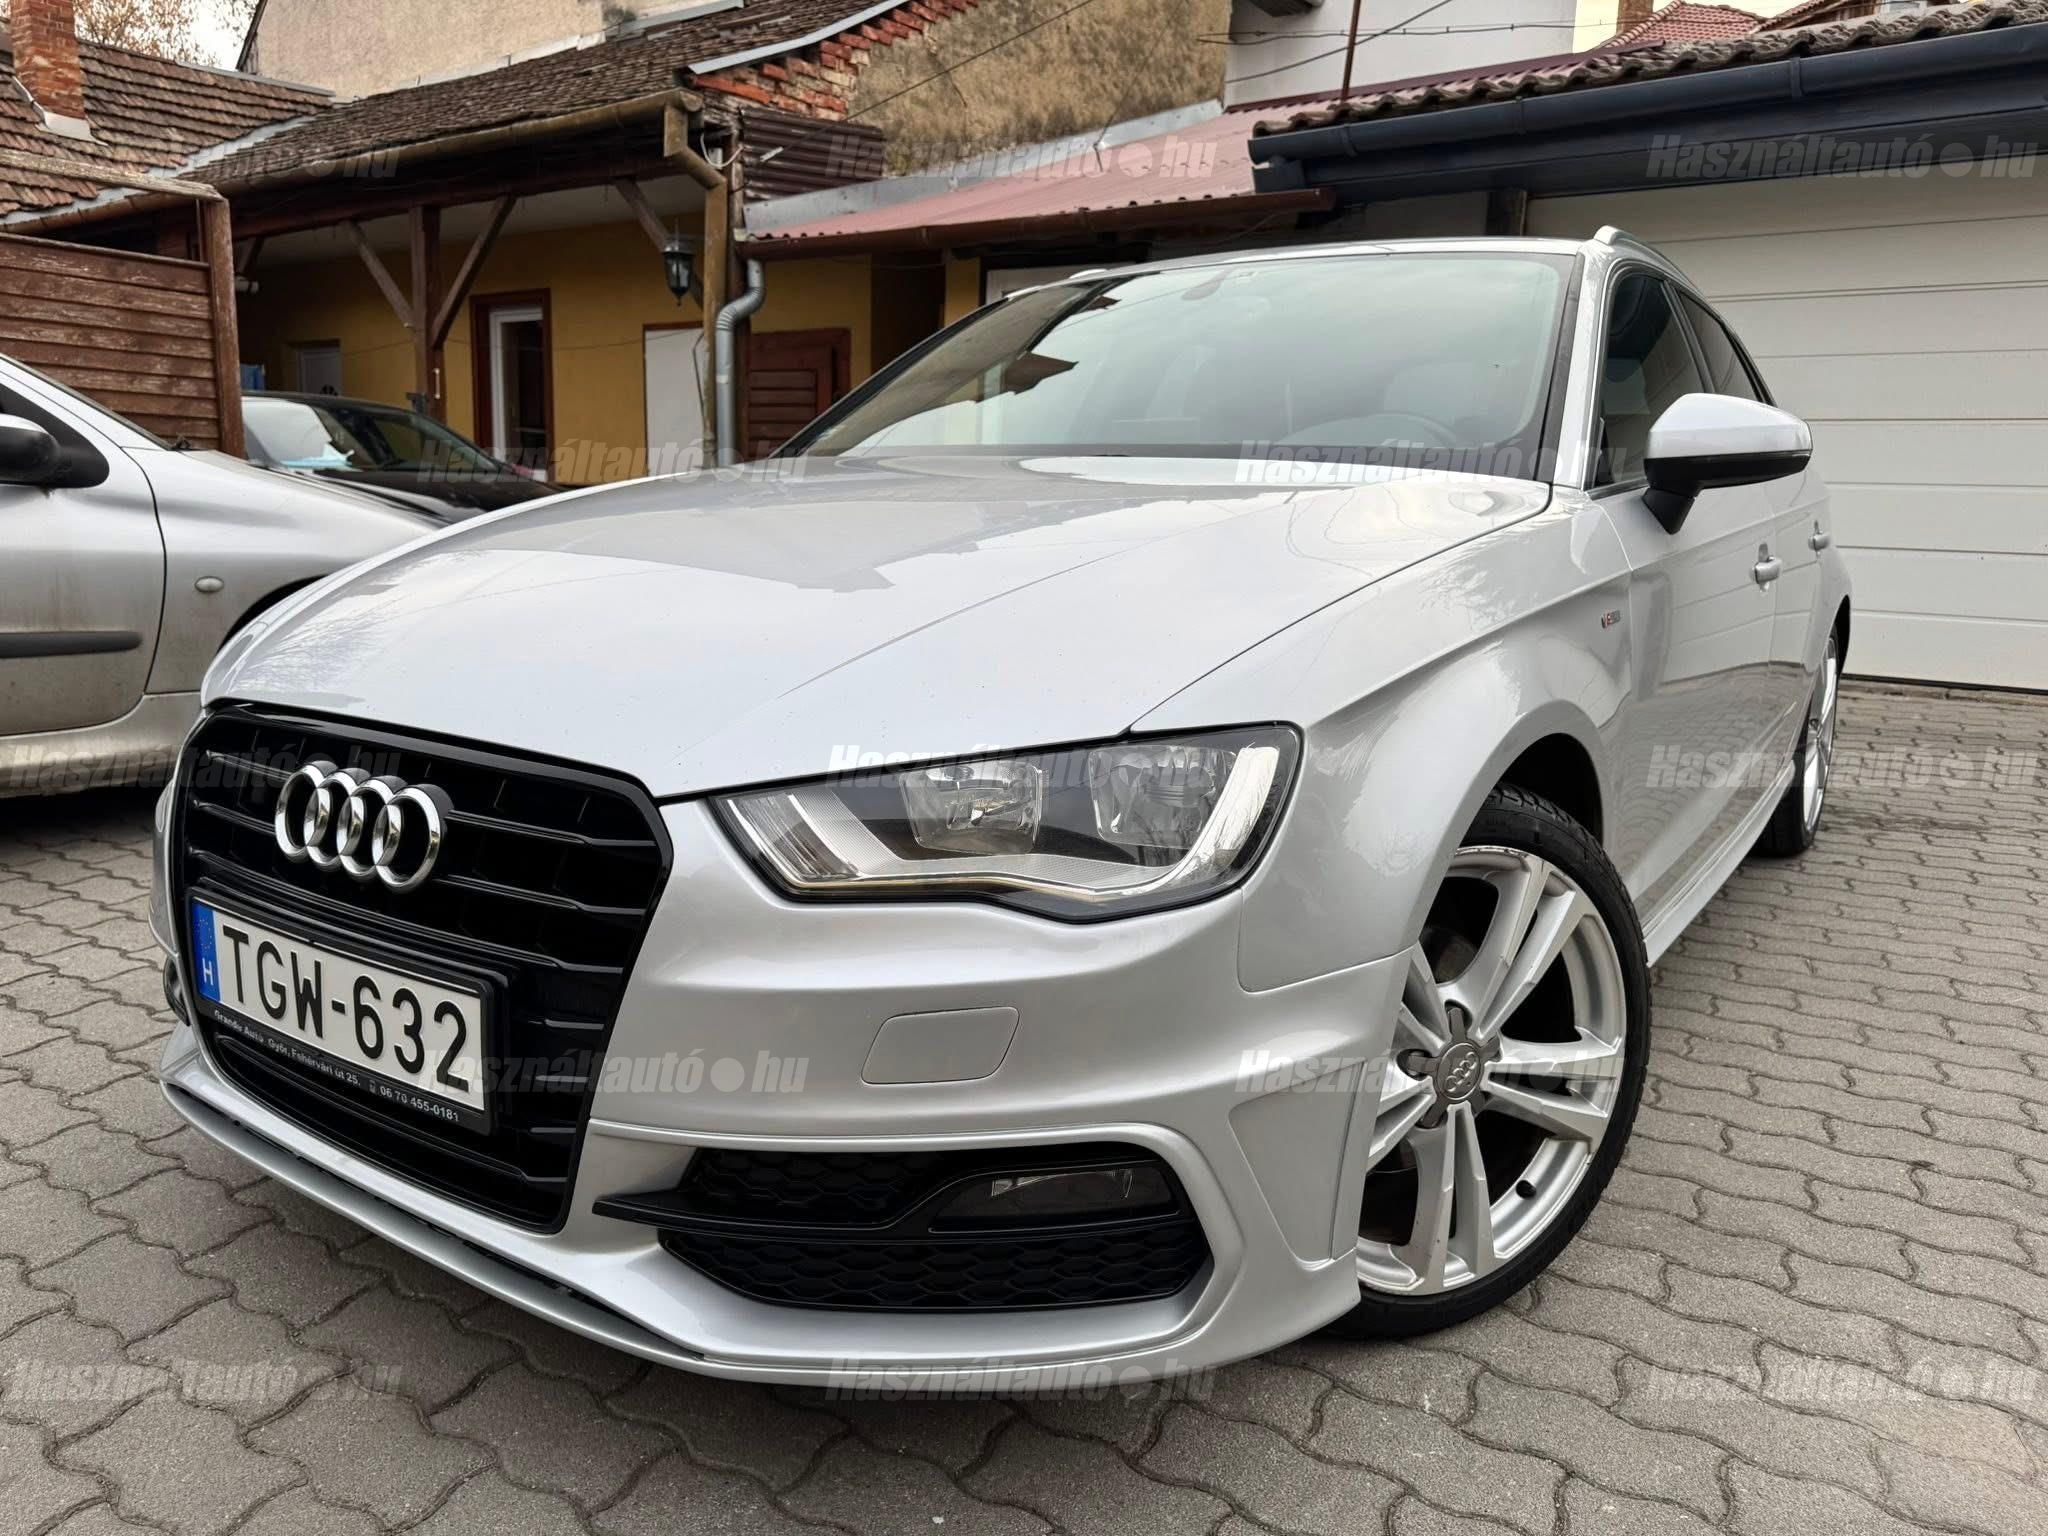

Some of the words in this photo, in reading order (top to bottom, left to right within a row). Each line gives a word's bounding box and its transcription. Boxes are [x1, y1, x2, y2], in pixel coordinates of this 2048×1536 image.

[202, 958, 214, 986] H
[222, 924, 470, 1093] TGW-632
[379, 1085, 393, 1098] 06
[394, 1090, 408, 1104] 70
[410, 1096, 460, 1122] 455-0181
